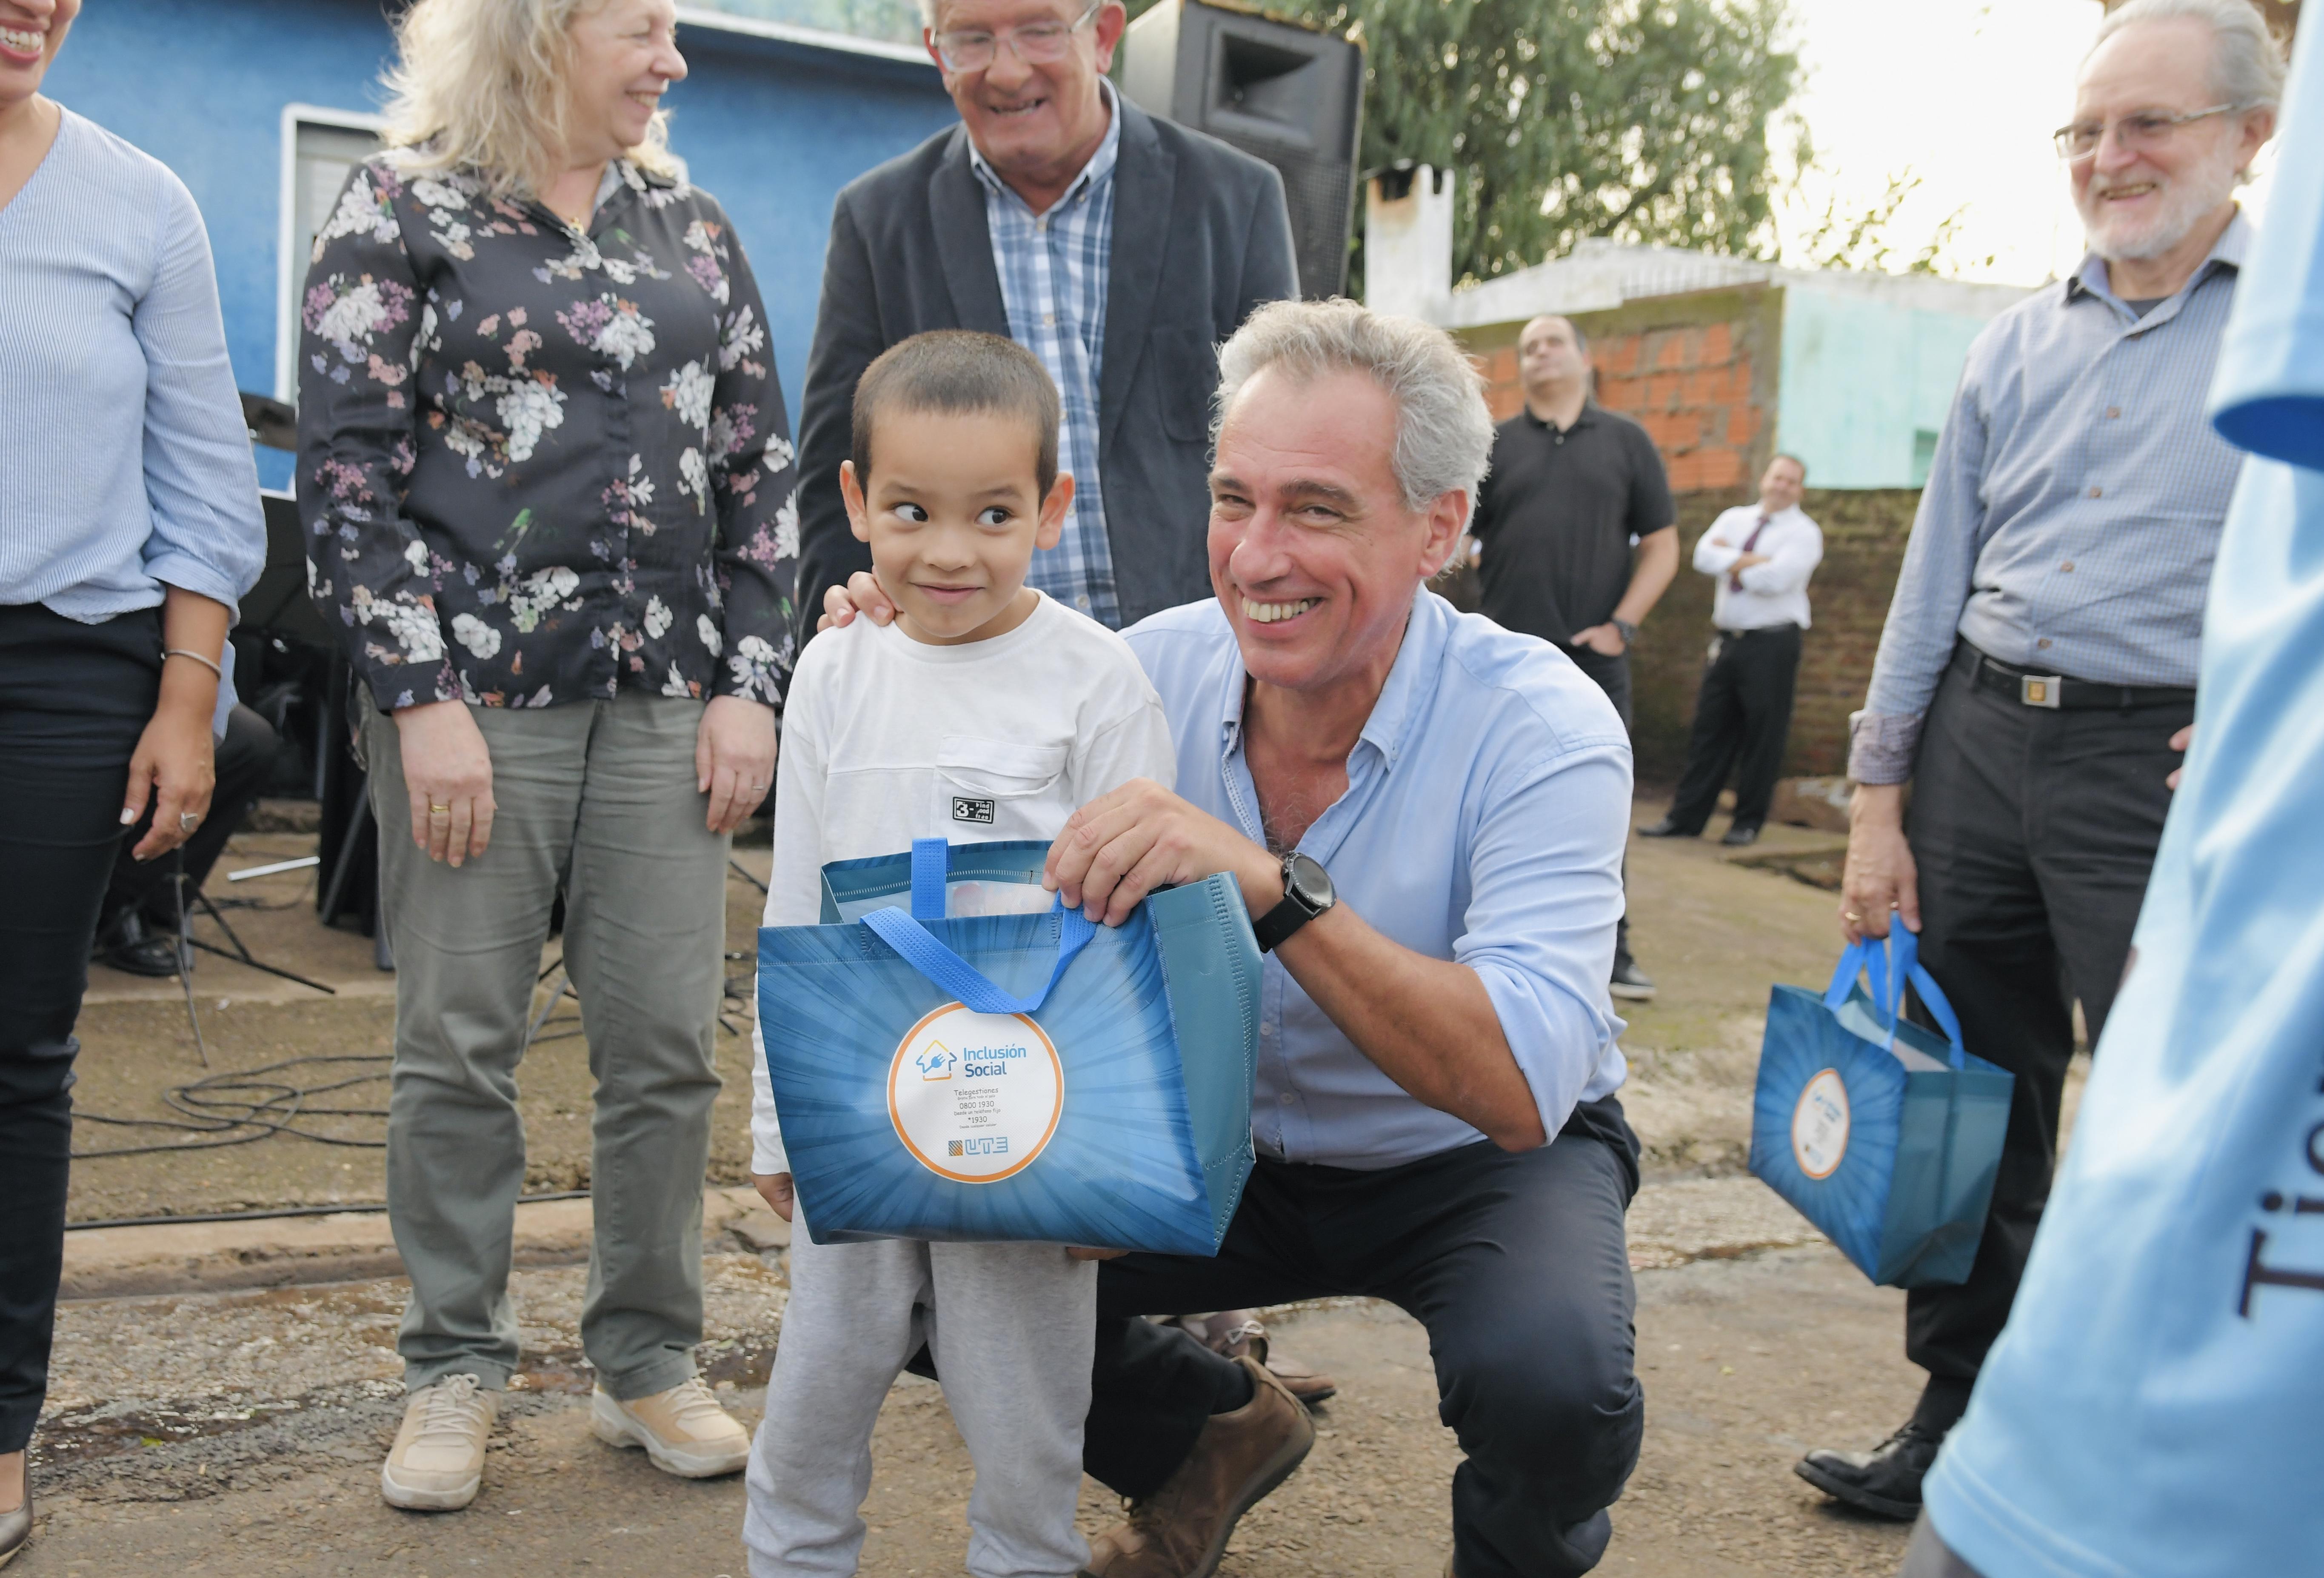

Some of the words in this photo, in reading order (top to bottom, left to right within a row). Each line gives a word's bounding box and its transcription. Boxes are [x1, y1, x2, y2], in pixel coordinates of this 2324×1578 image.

[964, 1043, 1026, 1061] Inclusión
[965, 1061, 1007, 1078] Social
[954, 1088, 999, 1097] Telegestiones
[965, 1137, 1008, 1155] UTE
